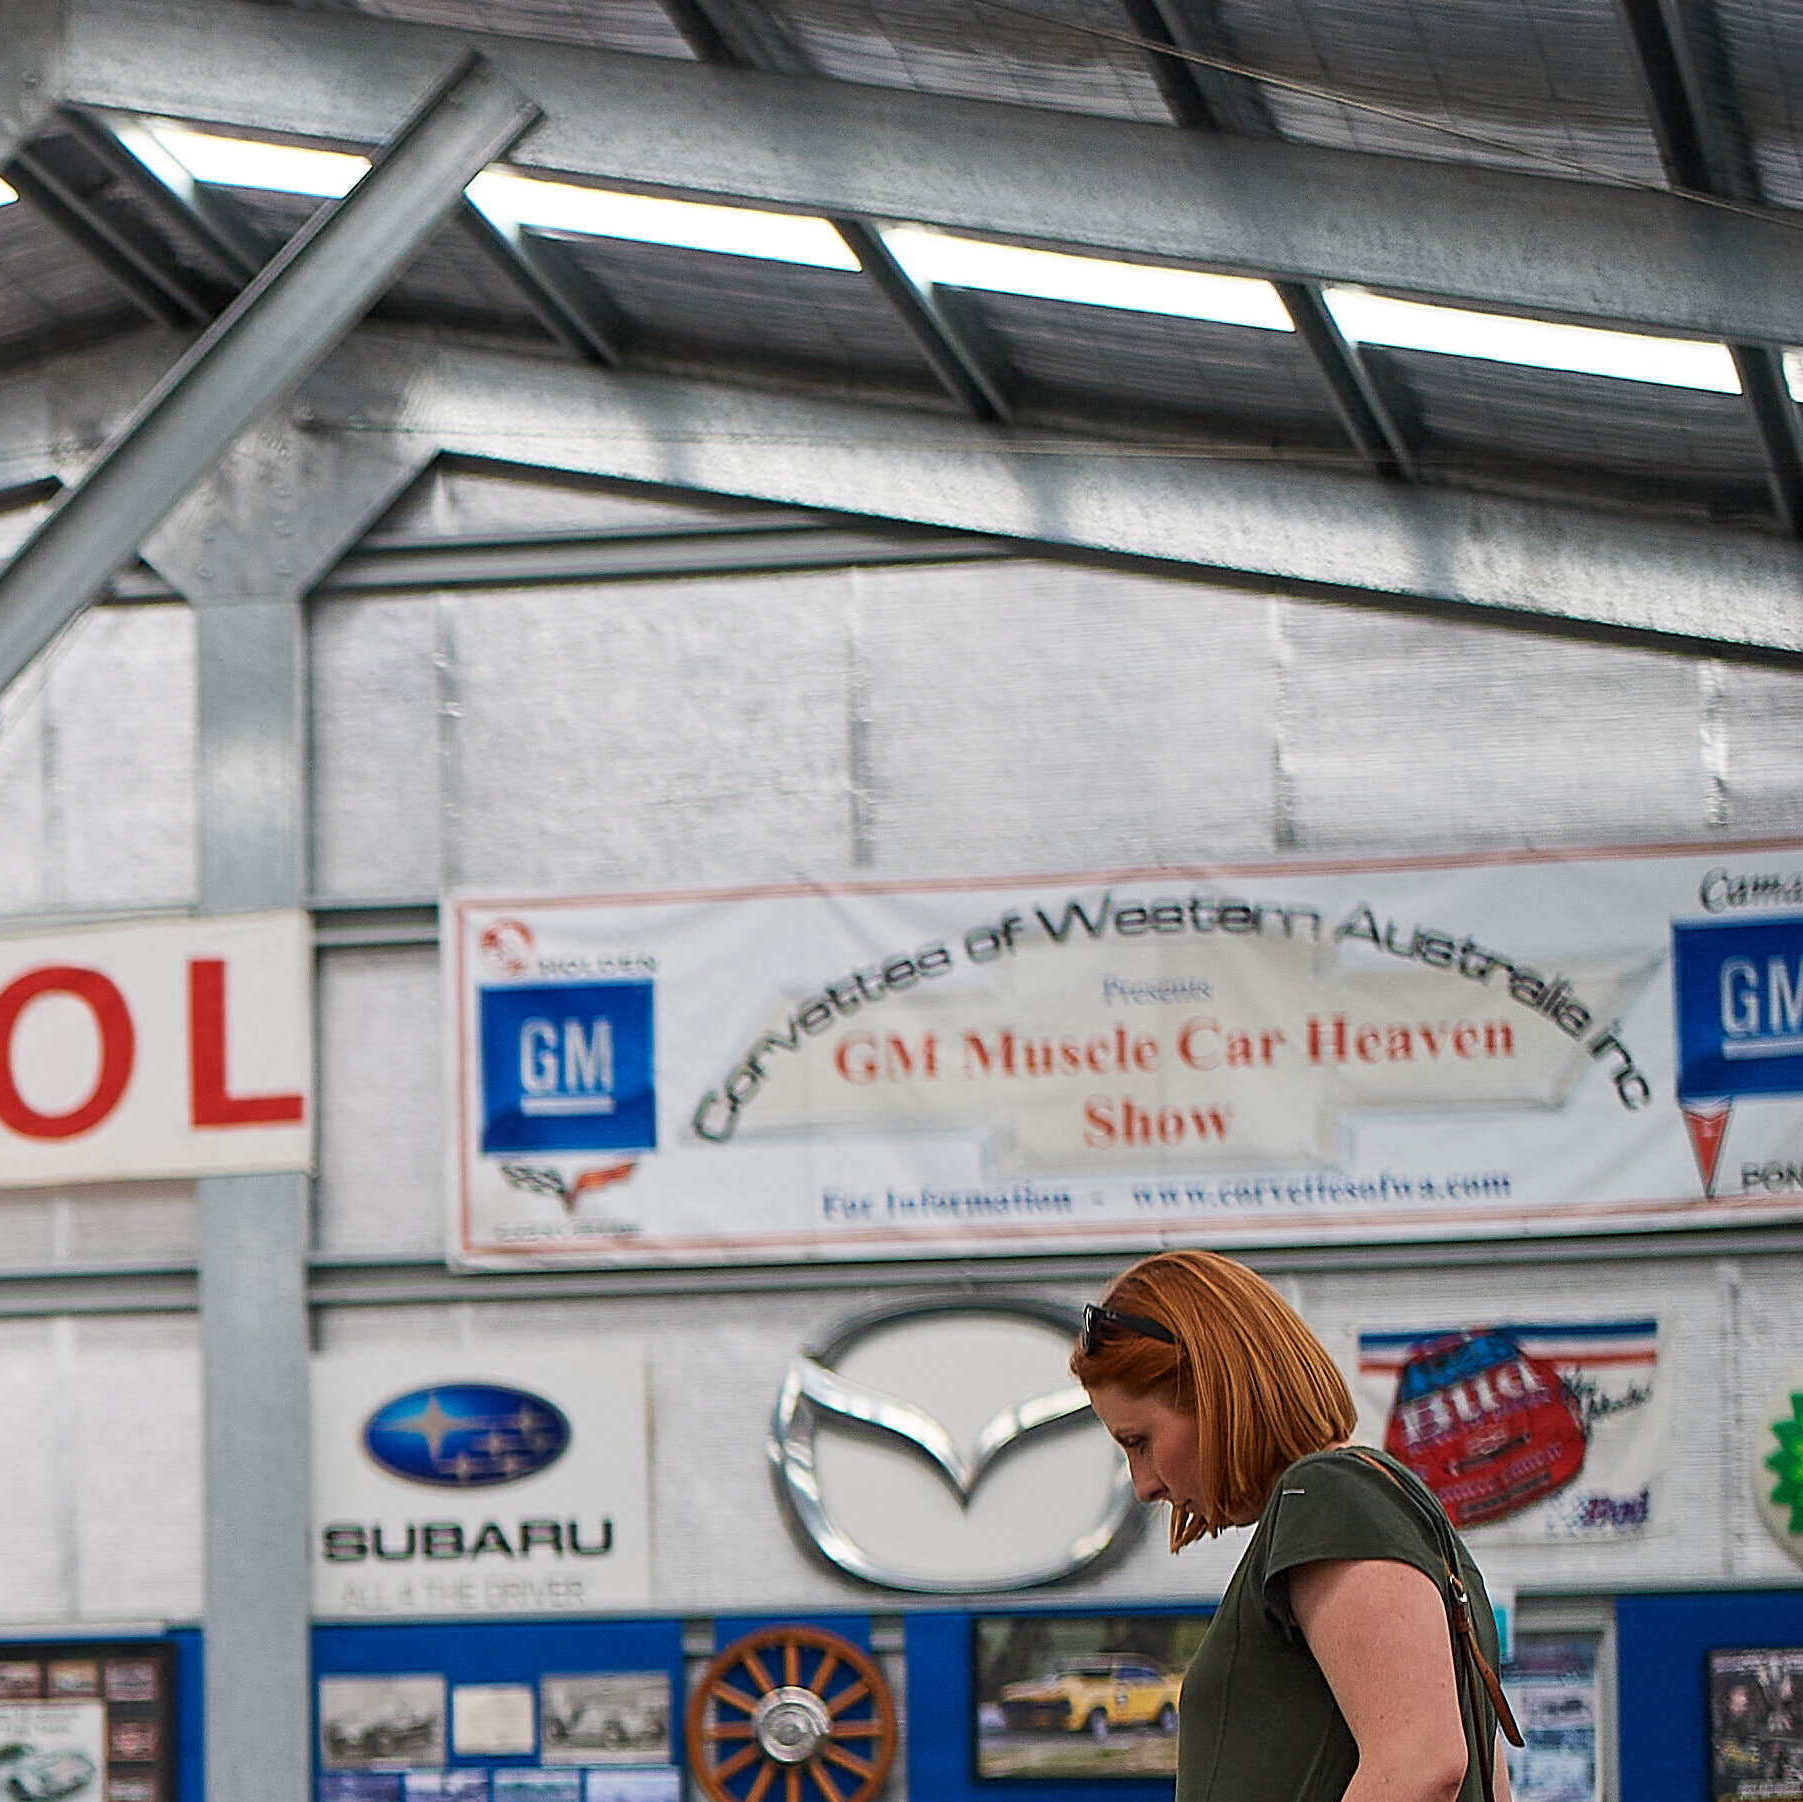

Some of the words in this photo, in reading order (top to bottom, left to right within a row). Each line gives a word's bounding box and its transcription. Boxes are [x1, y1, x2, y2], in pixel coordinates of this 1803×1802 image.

[692, 943, 952, 1144] Corvettes
[964, 914, 1025, 963] of
[1036, 892, 1321, 943] Western
[1335, 901, 1593, 1041] Australia
[832, 1029, 939, 1086] GM
[963, 1019, 1161, 1081] Muscle
[1175, 1015, 1287, 1072] Car
[1306, 1012, 1518, 1066] Heaven
[520, 1014, 614, 1097] GM
[1083, 1091, 1232, 1151] Show
[821, 1185, 875, 1221] For
[886, 1179, 1074, 1216] Information
[323, 1517, 614, 1563] SUBARU
